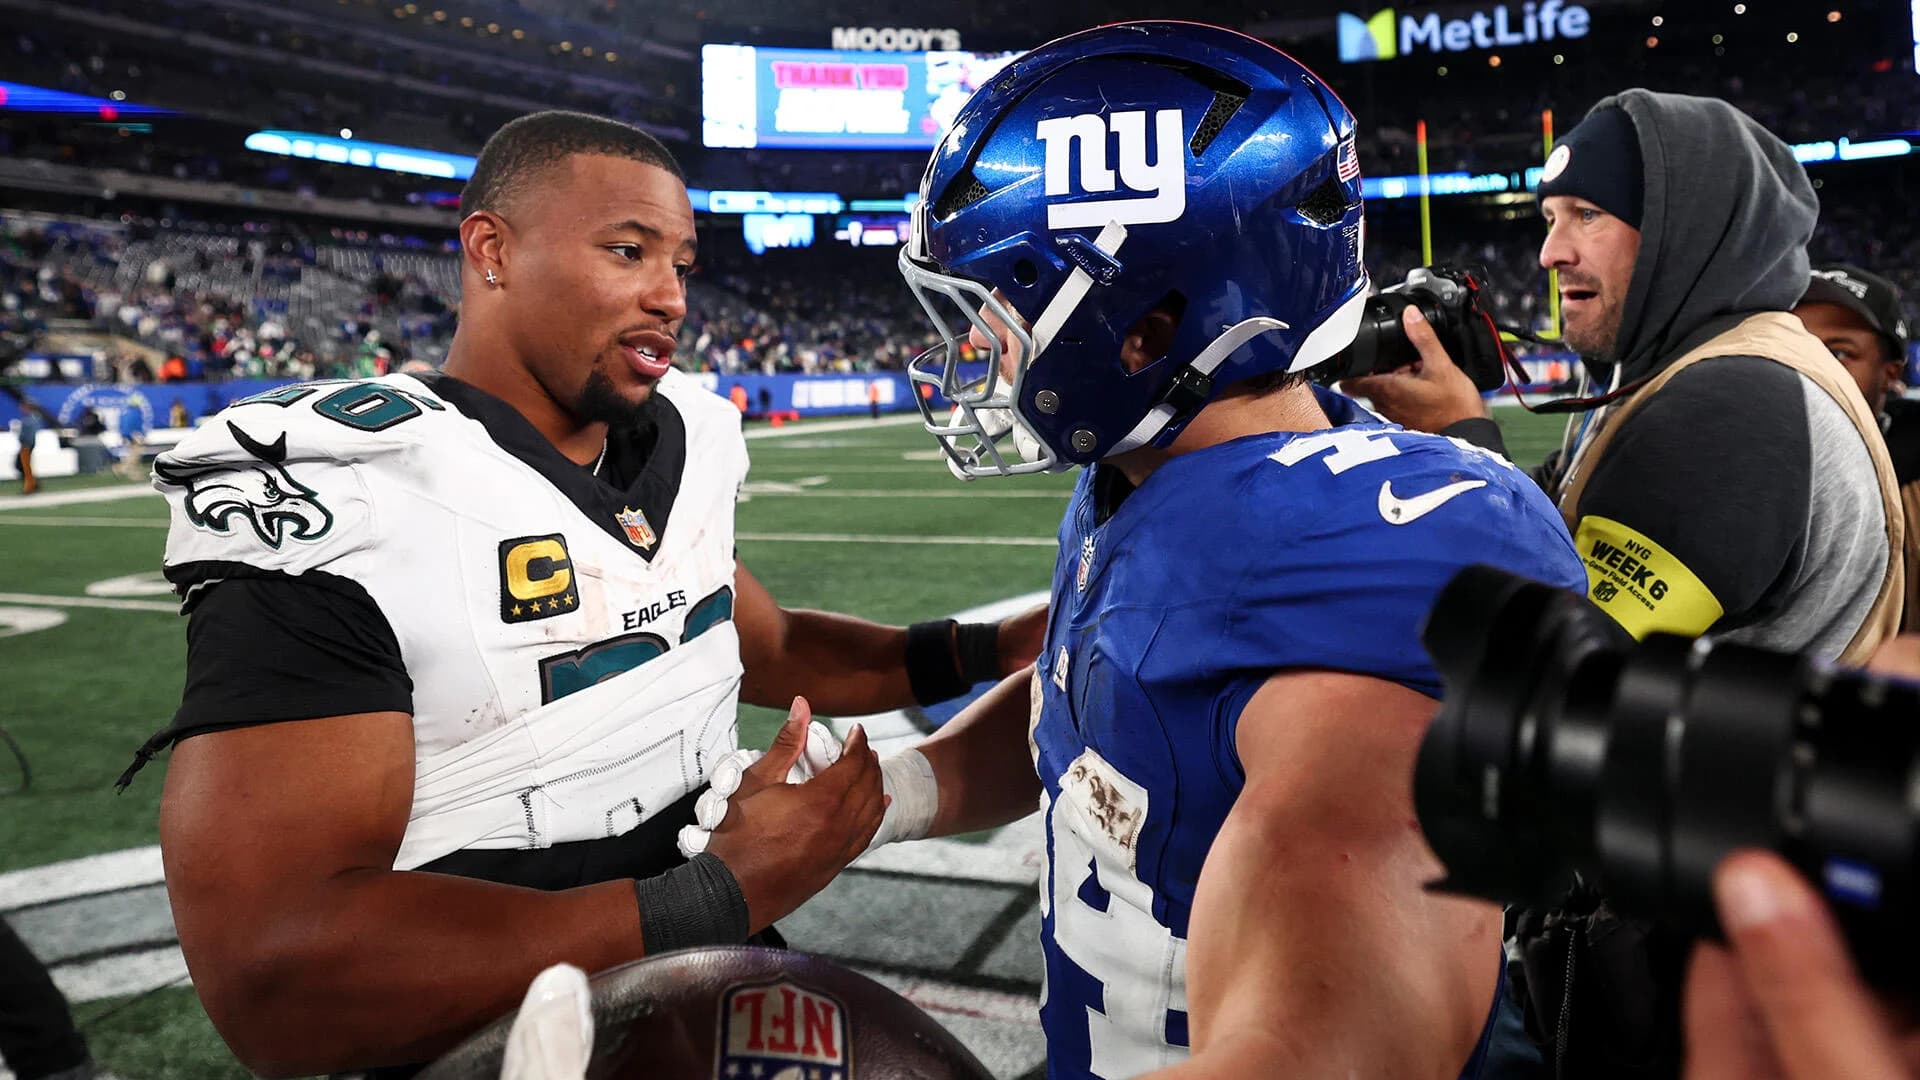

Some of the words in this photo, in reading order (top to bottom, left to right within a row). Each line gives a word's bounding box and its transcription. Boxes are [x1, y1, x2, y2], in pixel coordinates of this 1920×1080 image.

[832, 27, 961, 51] MOODY'S
[1401, 0, 1591, 55] MetLife
[771, 62, 858, 88] THANK
[860, 64, 908, 89] YOU
[506, 539, 571, 600] C
[1590, 540, 1655, 589] WEEK
[1649, 579, 1668, 600] 6
[1624, 539, 1652, 560] NYG
[1627, 585, 1655, 611] Access
[734, 986, 838, 1058] NFL
